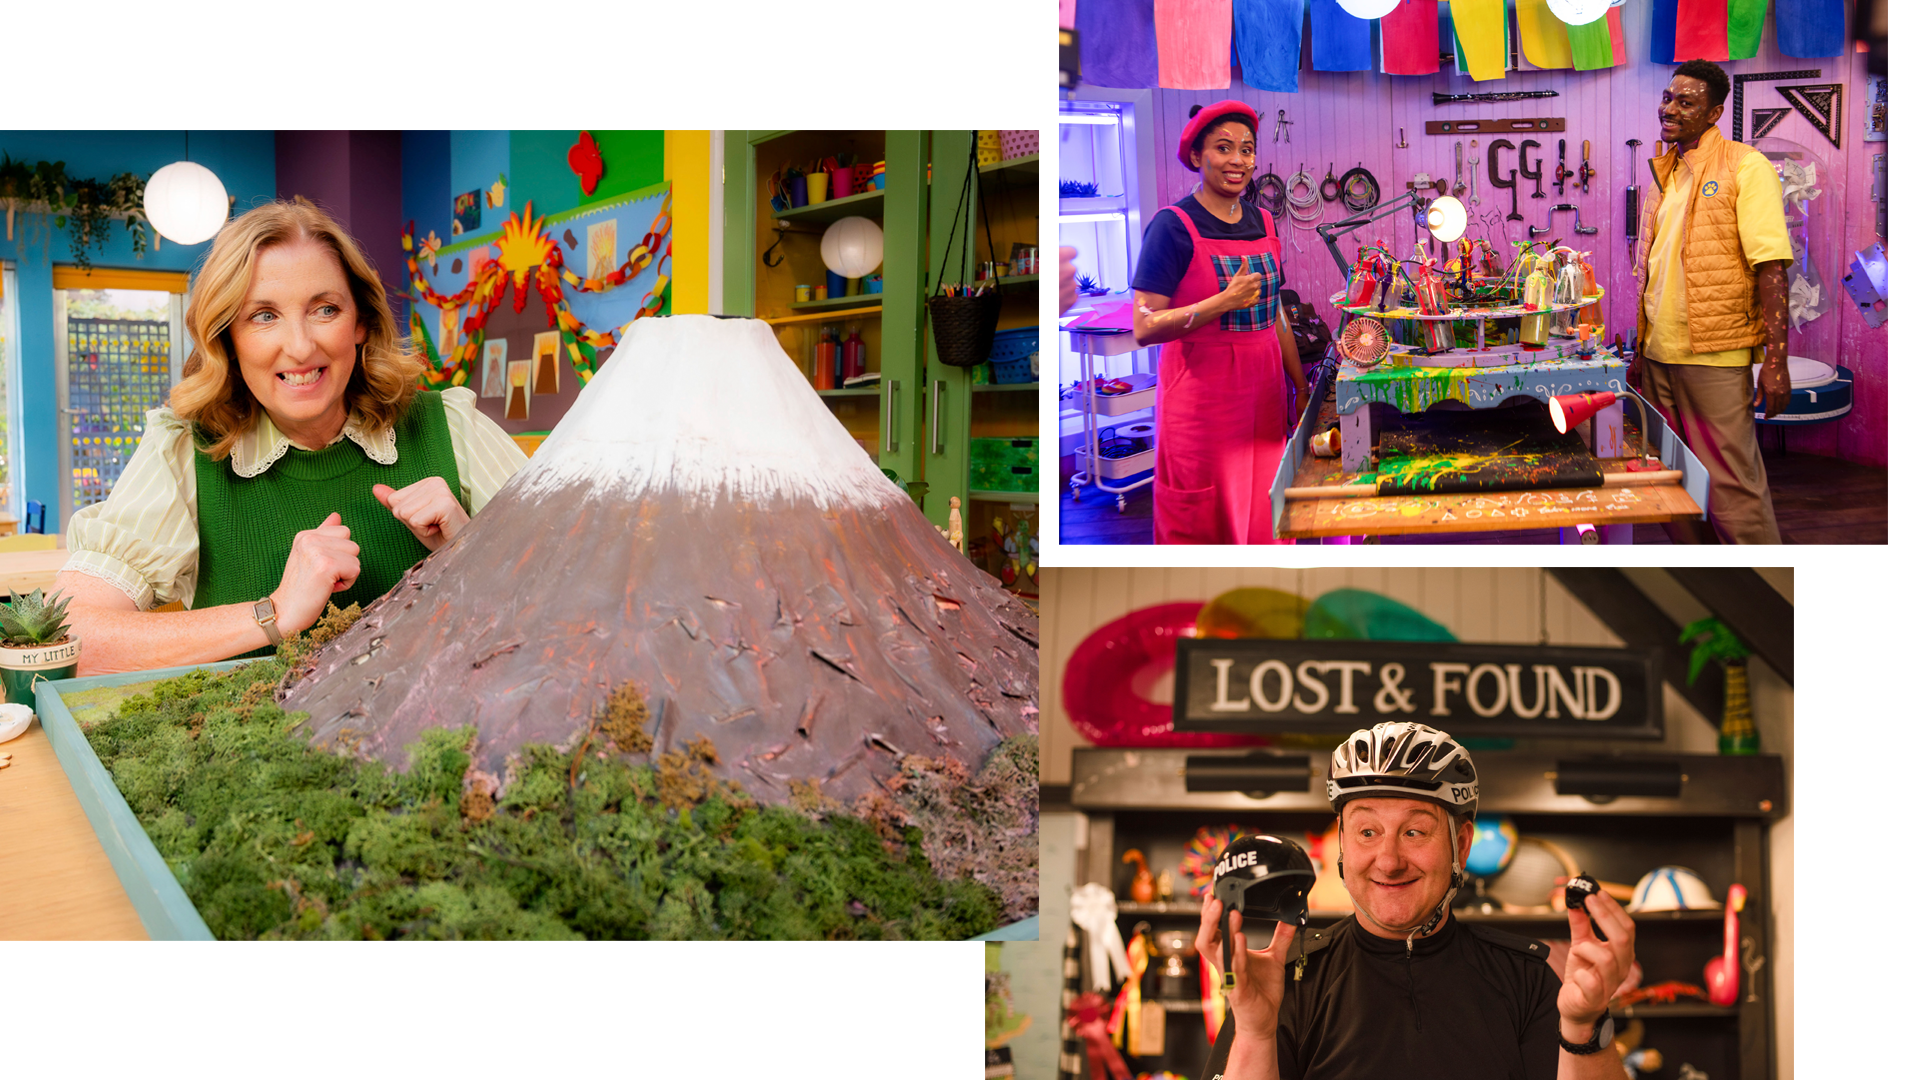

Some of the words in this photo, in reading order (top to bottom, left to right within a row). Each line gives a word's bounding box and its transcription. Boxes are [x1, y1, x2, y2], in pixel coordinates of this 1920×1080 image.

[23, 653, 38, 663] MY
[44, 646, 75, 662] LITTLE
[1210, 659, 1371, 714] LOST
[1373, 662, 1417, 713] &
[1429, 663, 1622, 720] FOUND
[1213, 851, 1257, 881] POLICE
